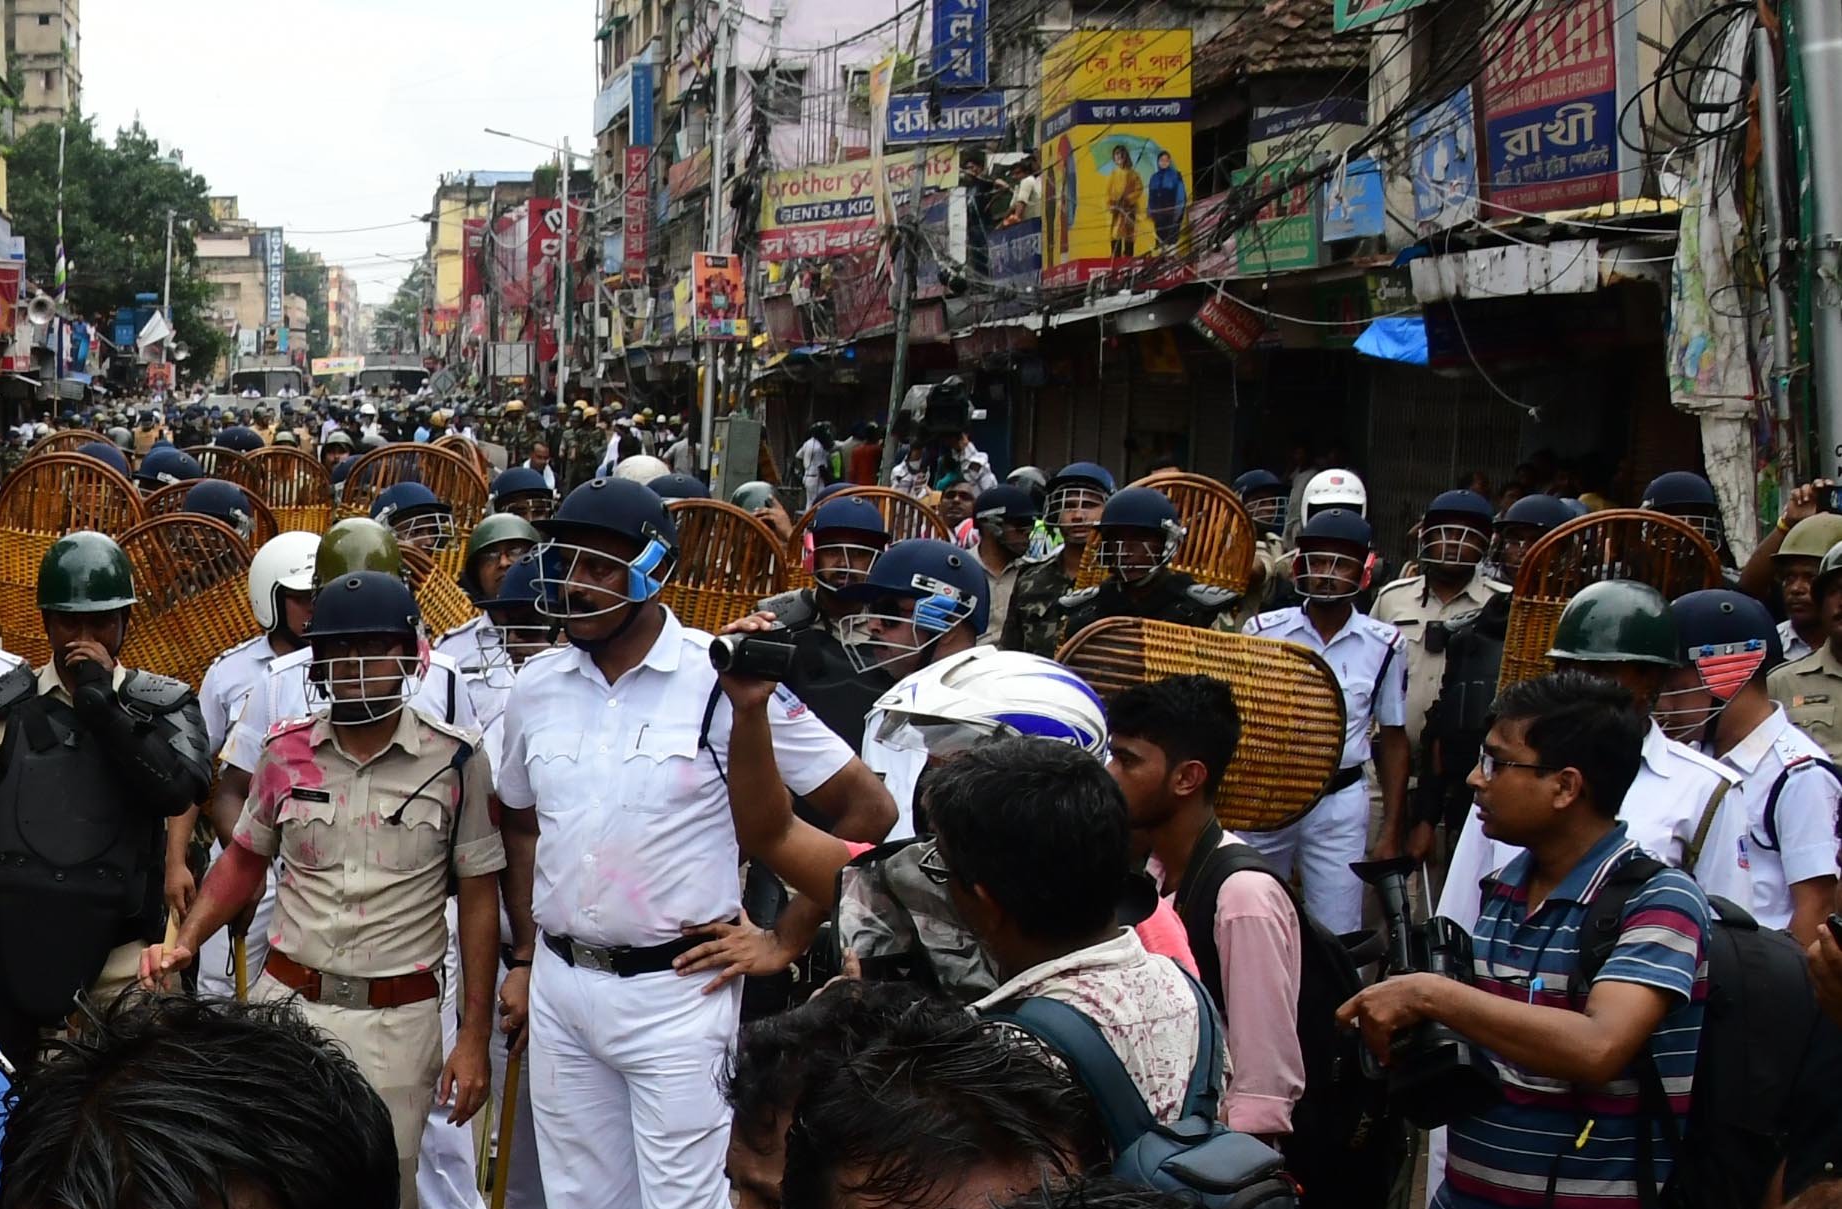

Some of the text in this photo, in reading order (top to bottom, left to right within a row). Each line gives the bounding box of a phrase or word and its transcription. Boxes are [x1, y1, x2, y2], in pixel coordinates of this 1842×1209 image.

[1499, 102, 1598, 162] রাখী
[765, 172, 844, 198] brother
[780, 204, 831, 222] GENTS
